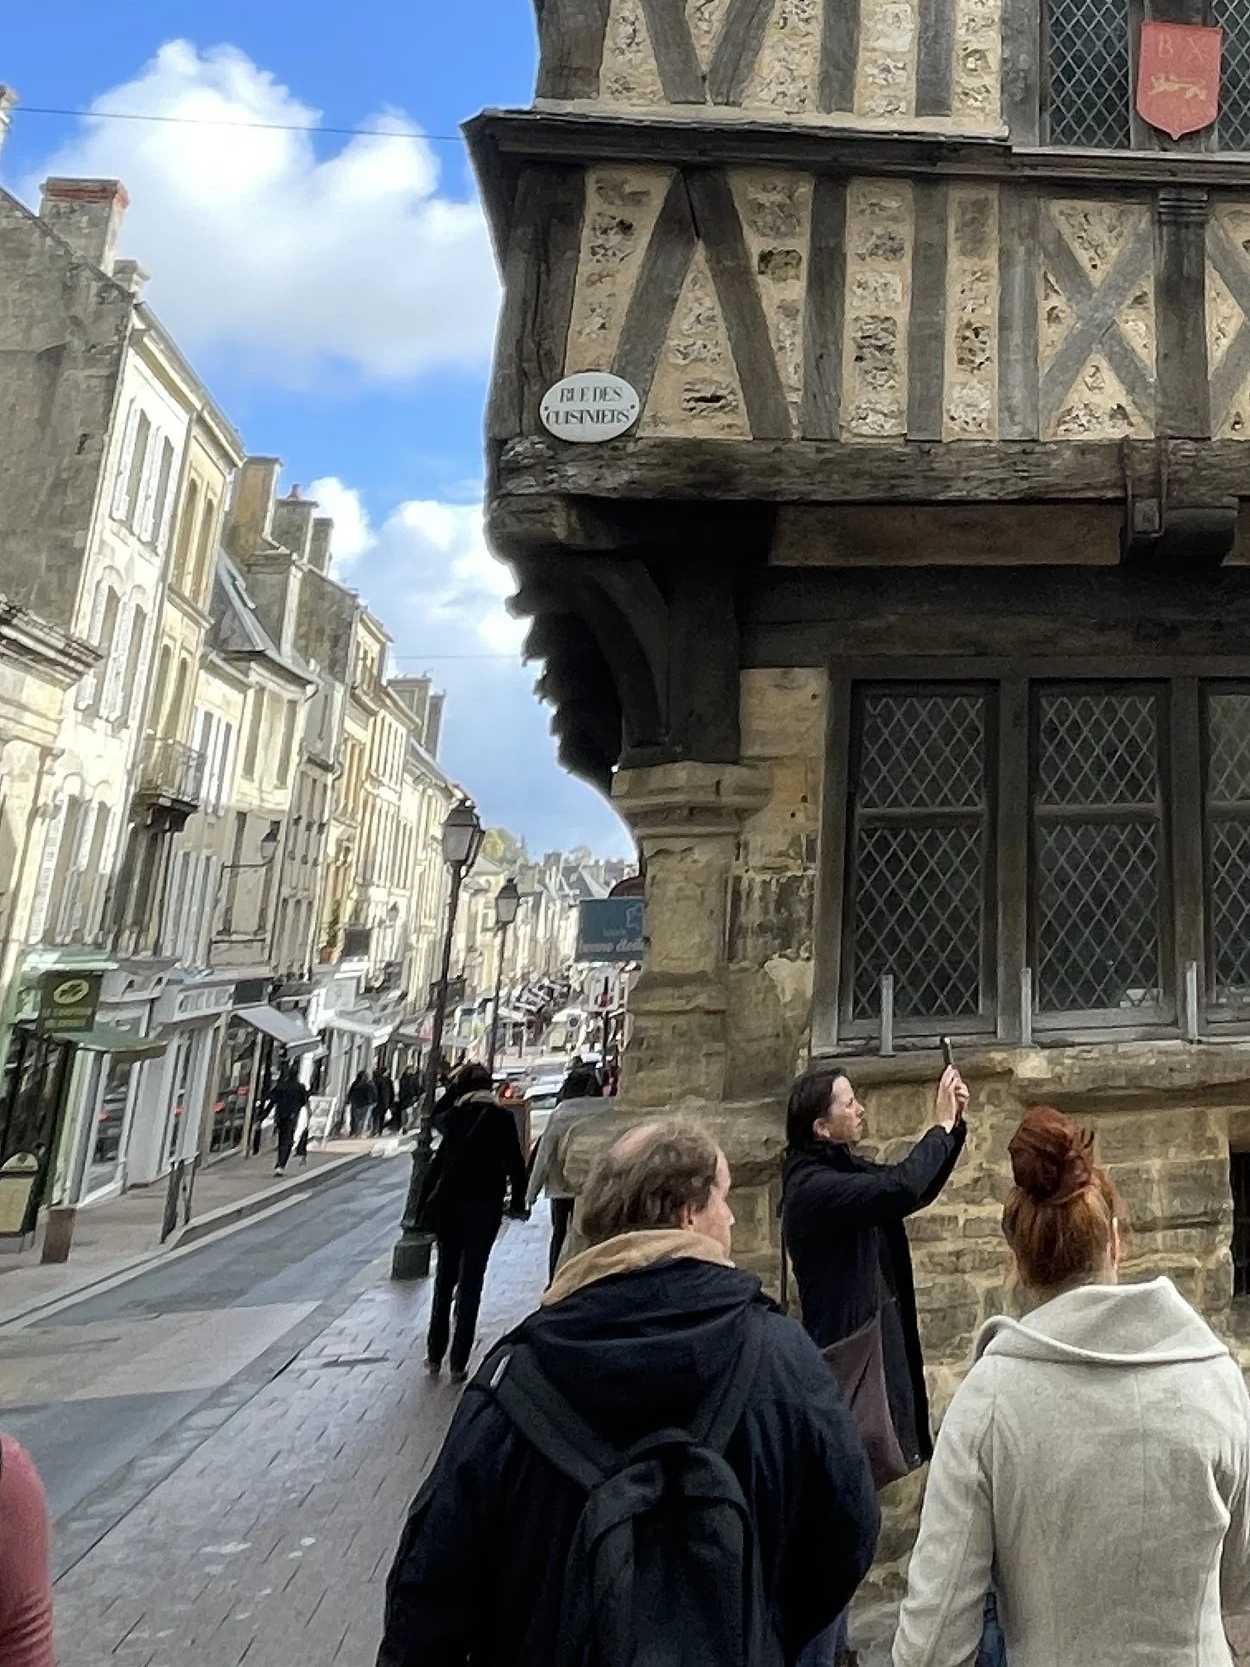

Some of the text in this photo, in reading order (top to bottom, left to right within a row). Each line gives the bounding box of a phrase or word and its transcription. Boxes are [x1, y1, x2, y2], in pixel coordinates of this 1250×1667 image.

[559, 386, 623, 403] RUE DES
[545, 409, 630, 425] CUISINIERS
